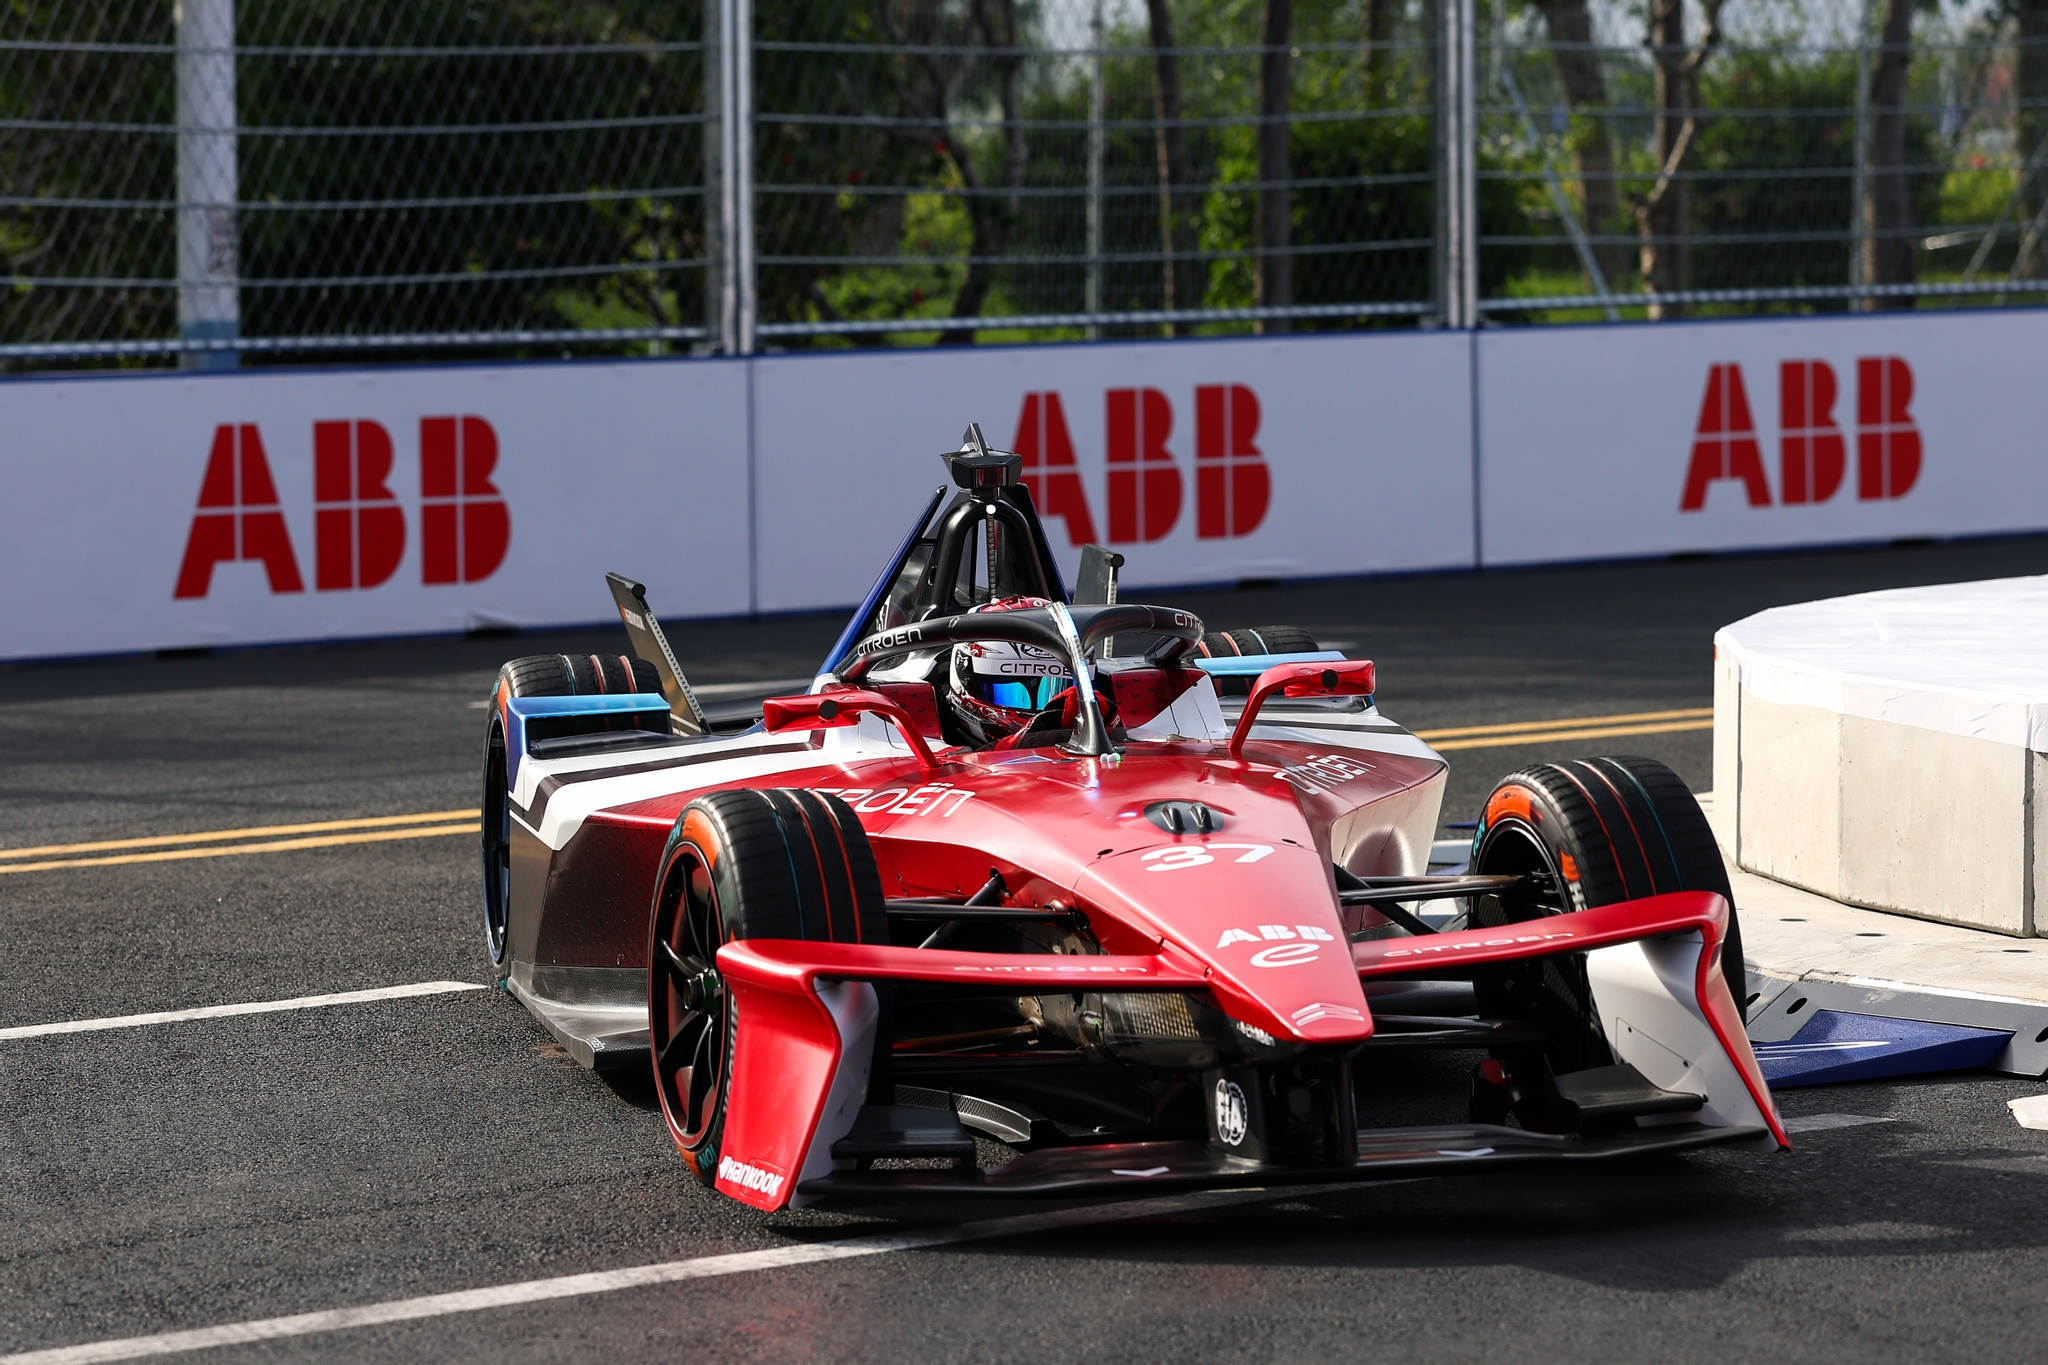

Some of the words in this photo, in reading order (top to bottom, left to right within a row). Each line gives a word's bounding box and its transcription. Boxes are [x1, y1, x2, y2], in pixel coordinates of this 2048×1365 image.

[1678, 354, 1925, 513] ABB
[1010, 382, 1272, 548] ABB
[173, 413, 512, 601] ABB
[857, 627, 922, 657] CITROEN
[1000, 662, 1073, 676] CITROE
[1140, 843, 1275, 872] 37
[1216, 924, 1335, 949] ABB
